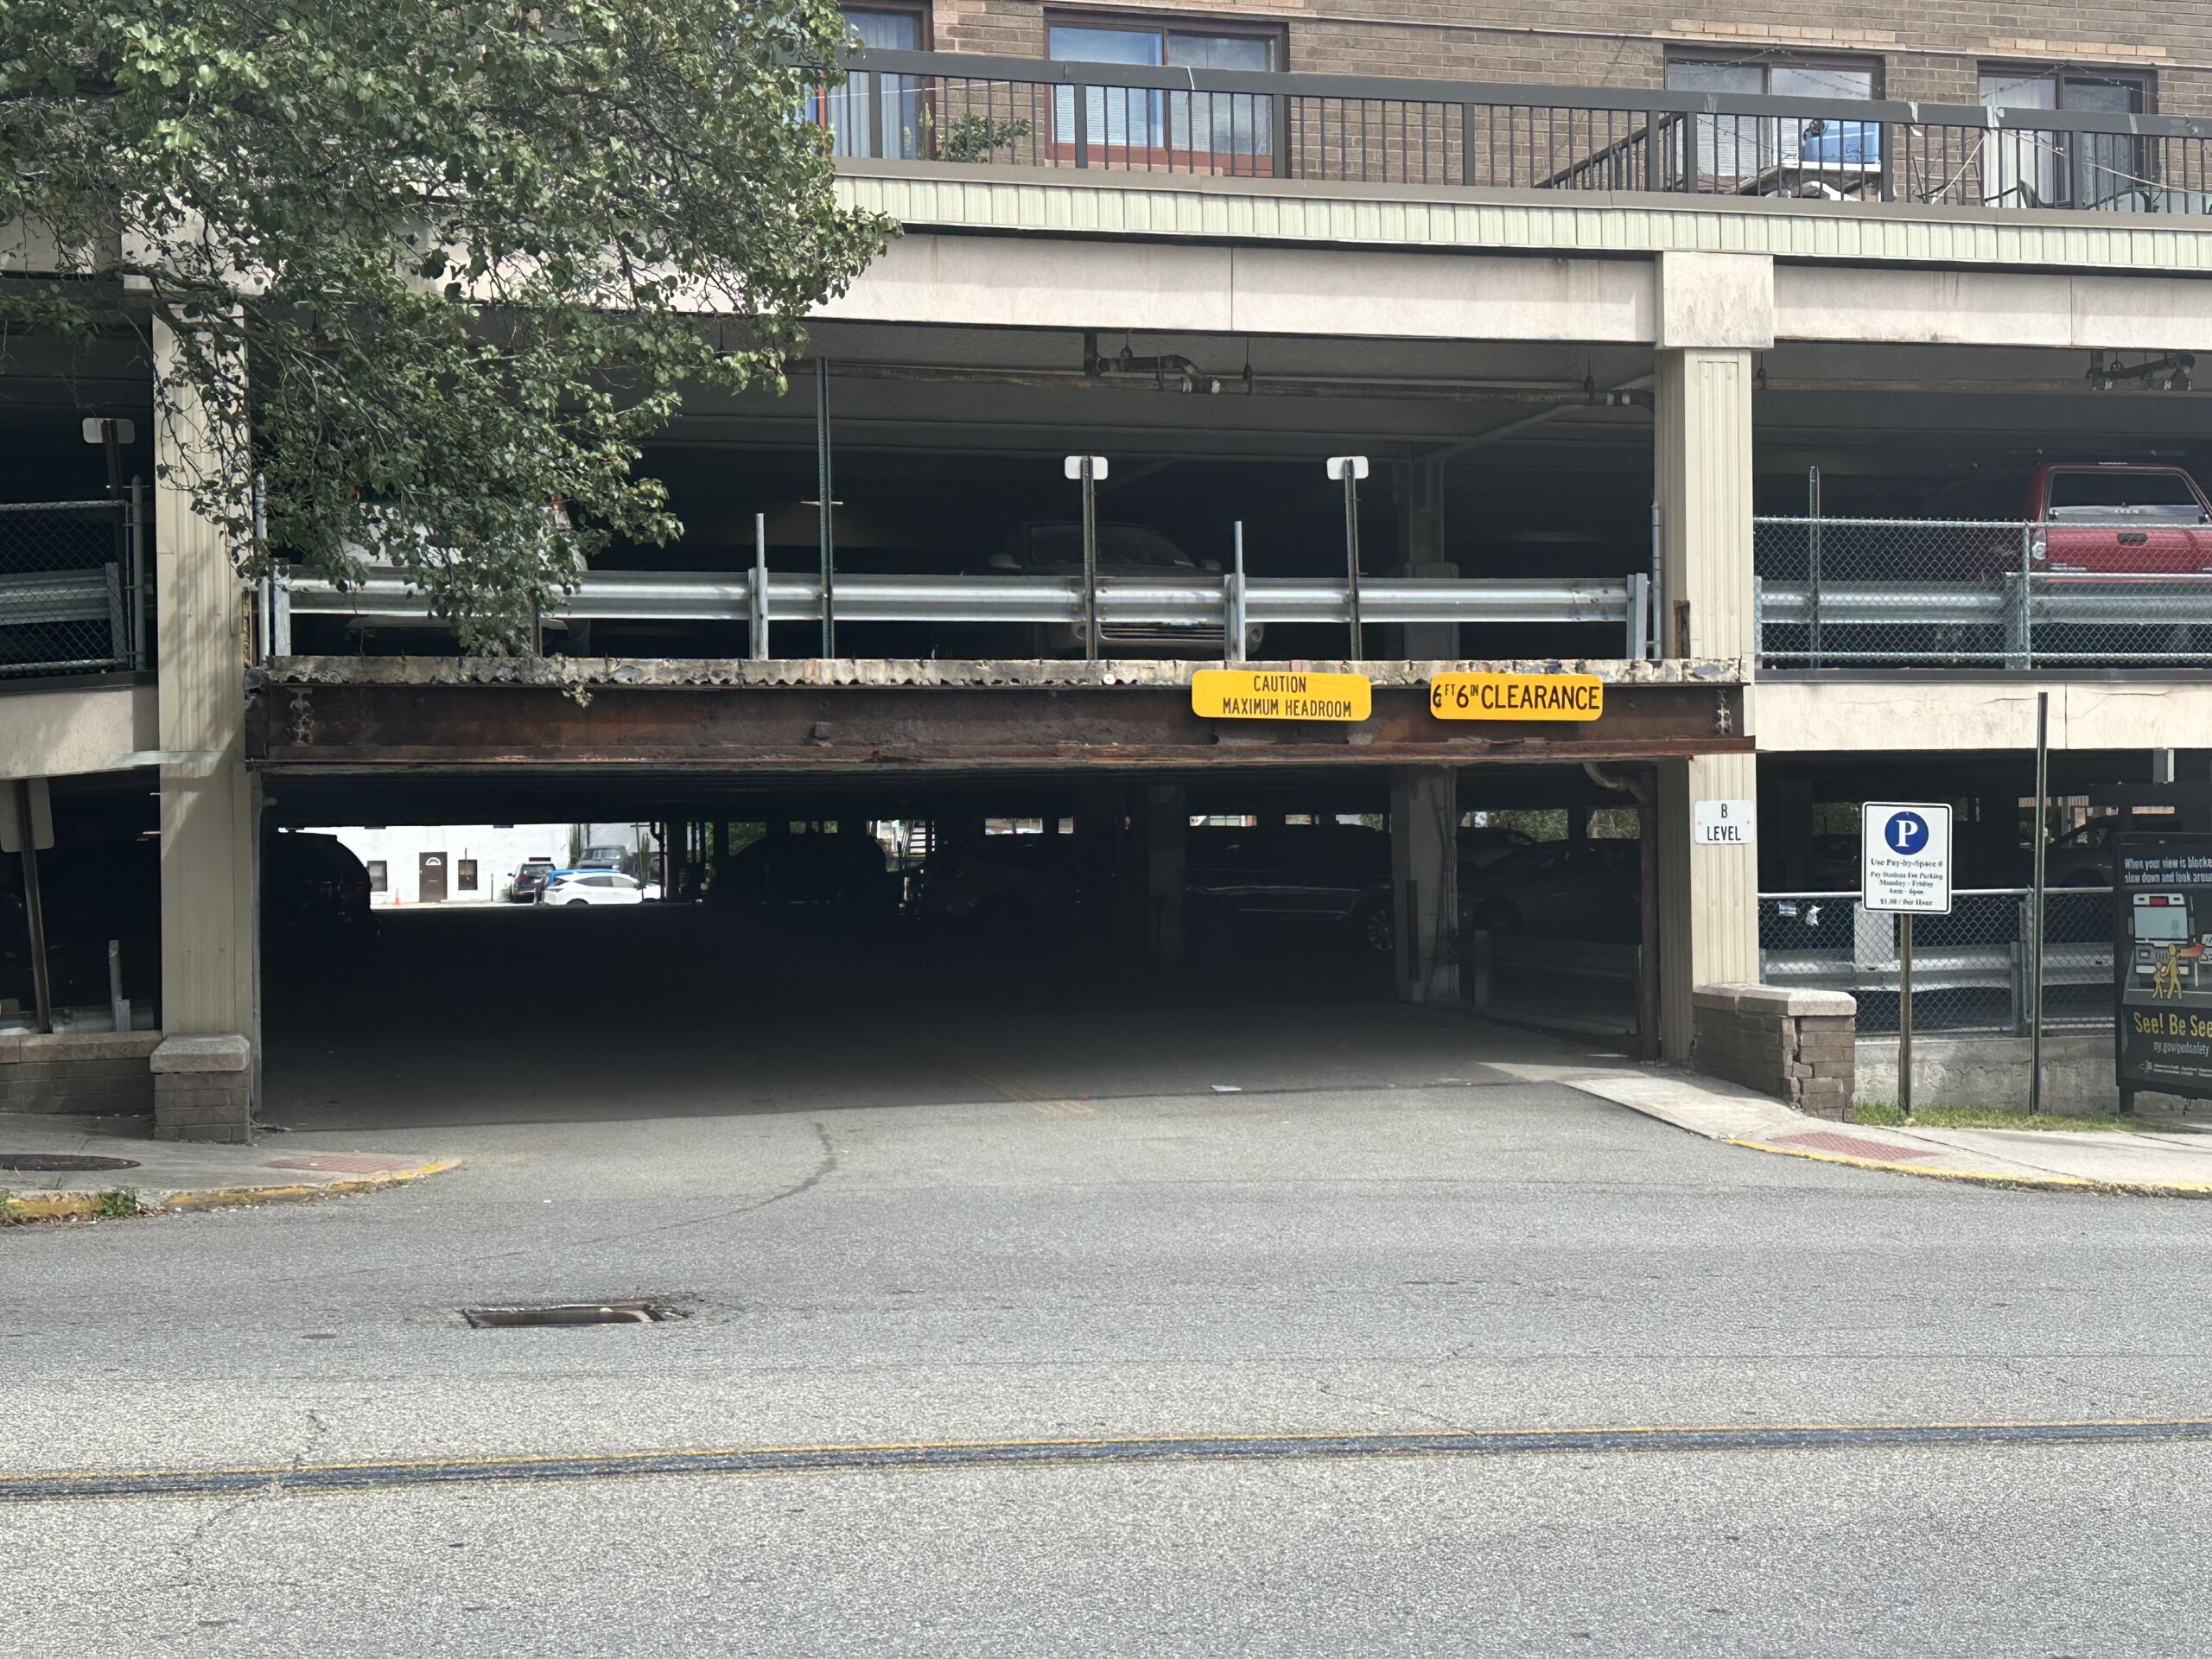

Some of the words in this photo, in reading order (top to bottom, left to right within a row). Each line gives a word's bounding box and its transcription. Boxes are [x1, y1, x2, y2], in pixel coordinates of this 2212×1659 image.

[1253, 675, 1306, 693] CAUTION
[1481, 684, 1600, 710] CLEARANCE
[1223, 697, 1279, 715] MAXIMUM
[1285, 699, 1351, 718] HEADROOM
[1720, 803, 1728, 818] B
[1707, 825, 1742, 842] LEVEL
[1895, 819, 1919, 848] P
[2124, 858, 2144, 869] When
[2145, 859, 2161, 871] your
[2162, 857, 2178, 869] view
[2179, 857, 2187, 869] is
[1879, 879, 1906, 887] Monday
[1912, 880, 1934, 888] Friday
[2124, 871, 2140, 883] slow
[2142, 872, 2160, 883] down
[2161, 871, 2175, 883] and
[2176, 871, 2191, 883] look
[2133, 1011, 2164, 1035] See!
[2169, 1013, 2186, 1036] Be
[2153, 1040, 2210, 1058] ny.gov/pedsafety
